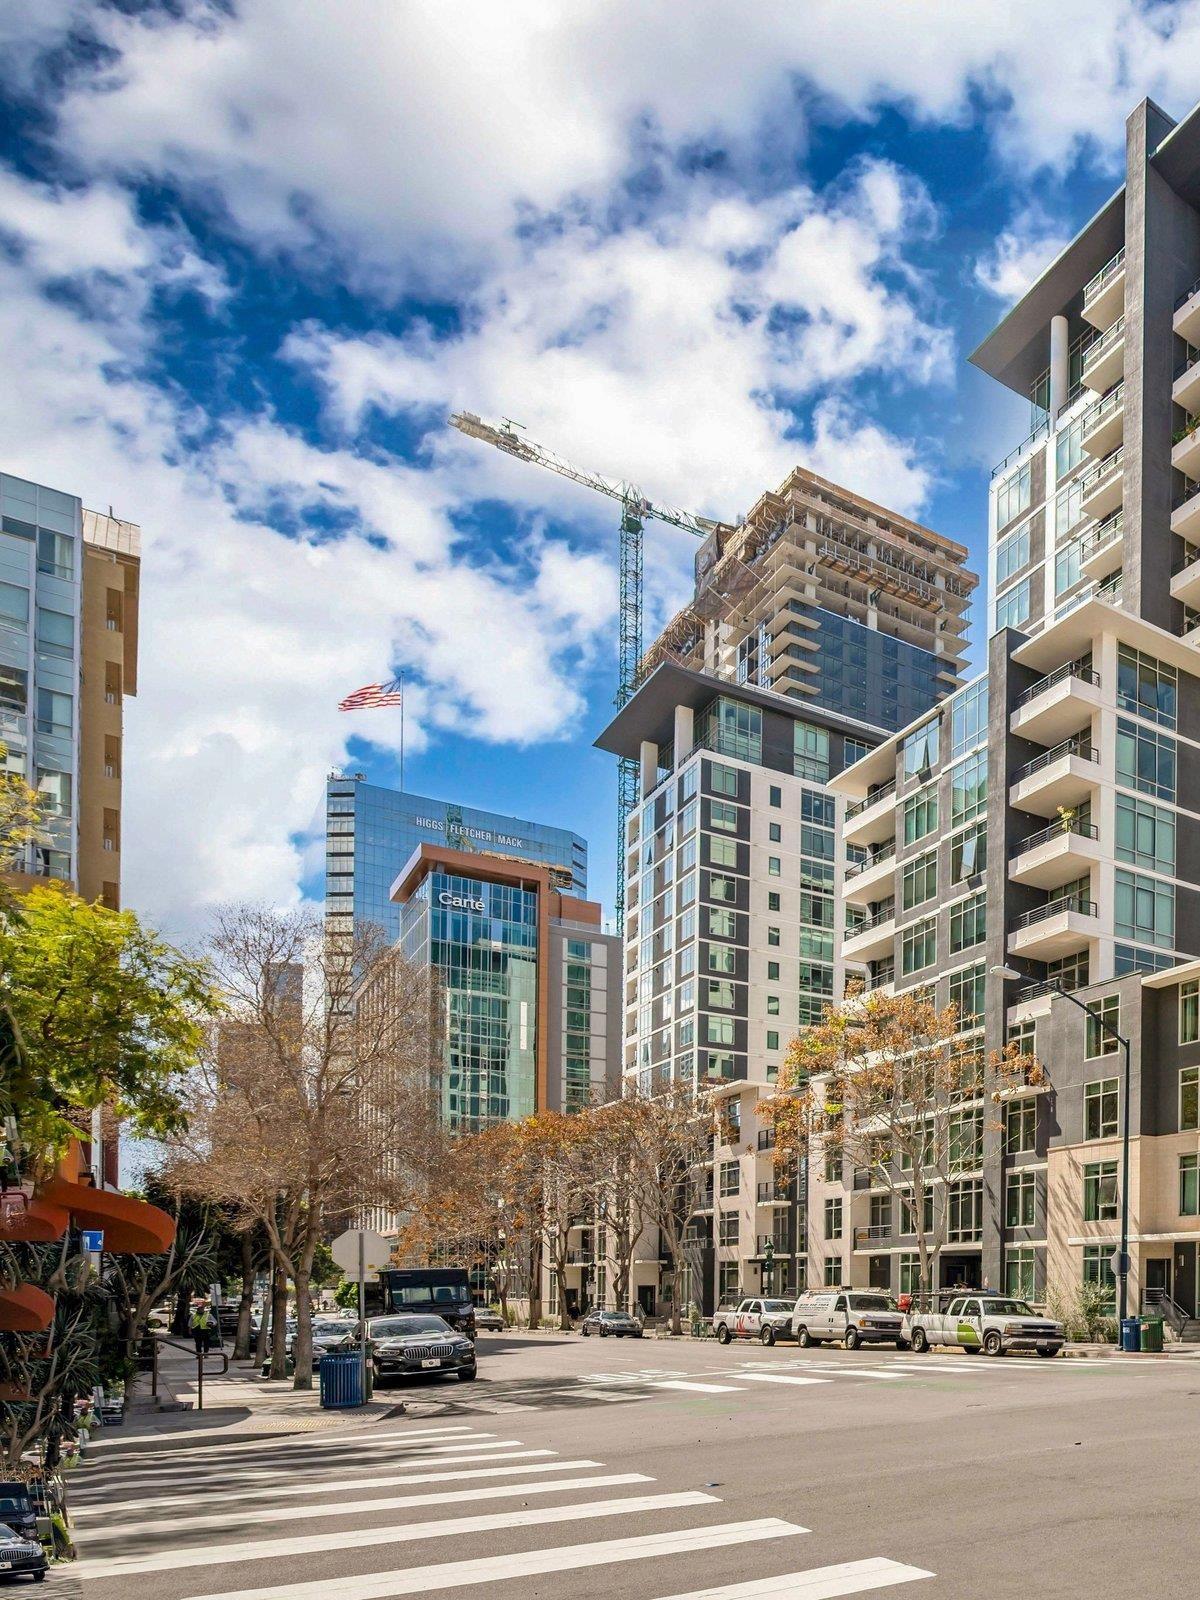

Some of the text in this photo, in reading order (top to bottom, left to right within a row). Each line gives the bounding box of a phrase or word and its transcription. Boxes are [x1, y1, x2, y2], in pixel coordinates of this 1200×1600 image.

[415, 816, 523, 849] HIGGS FLETCHER MACK
[438, 892, 486, 911] Carté
